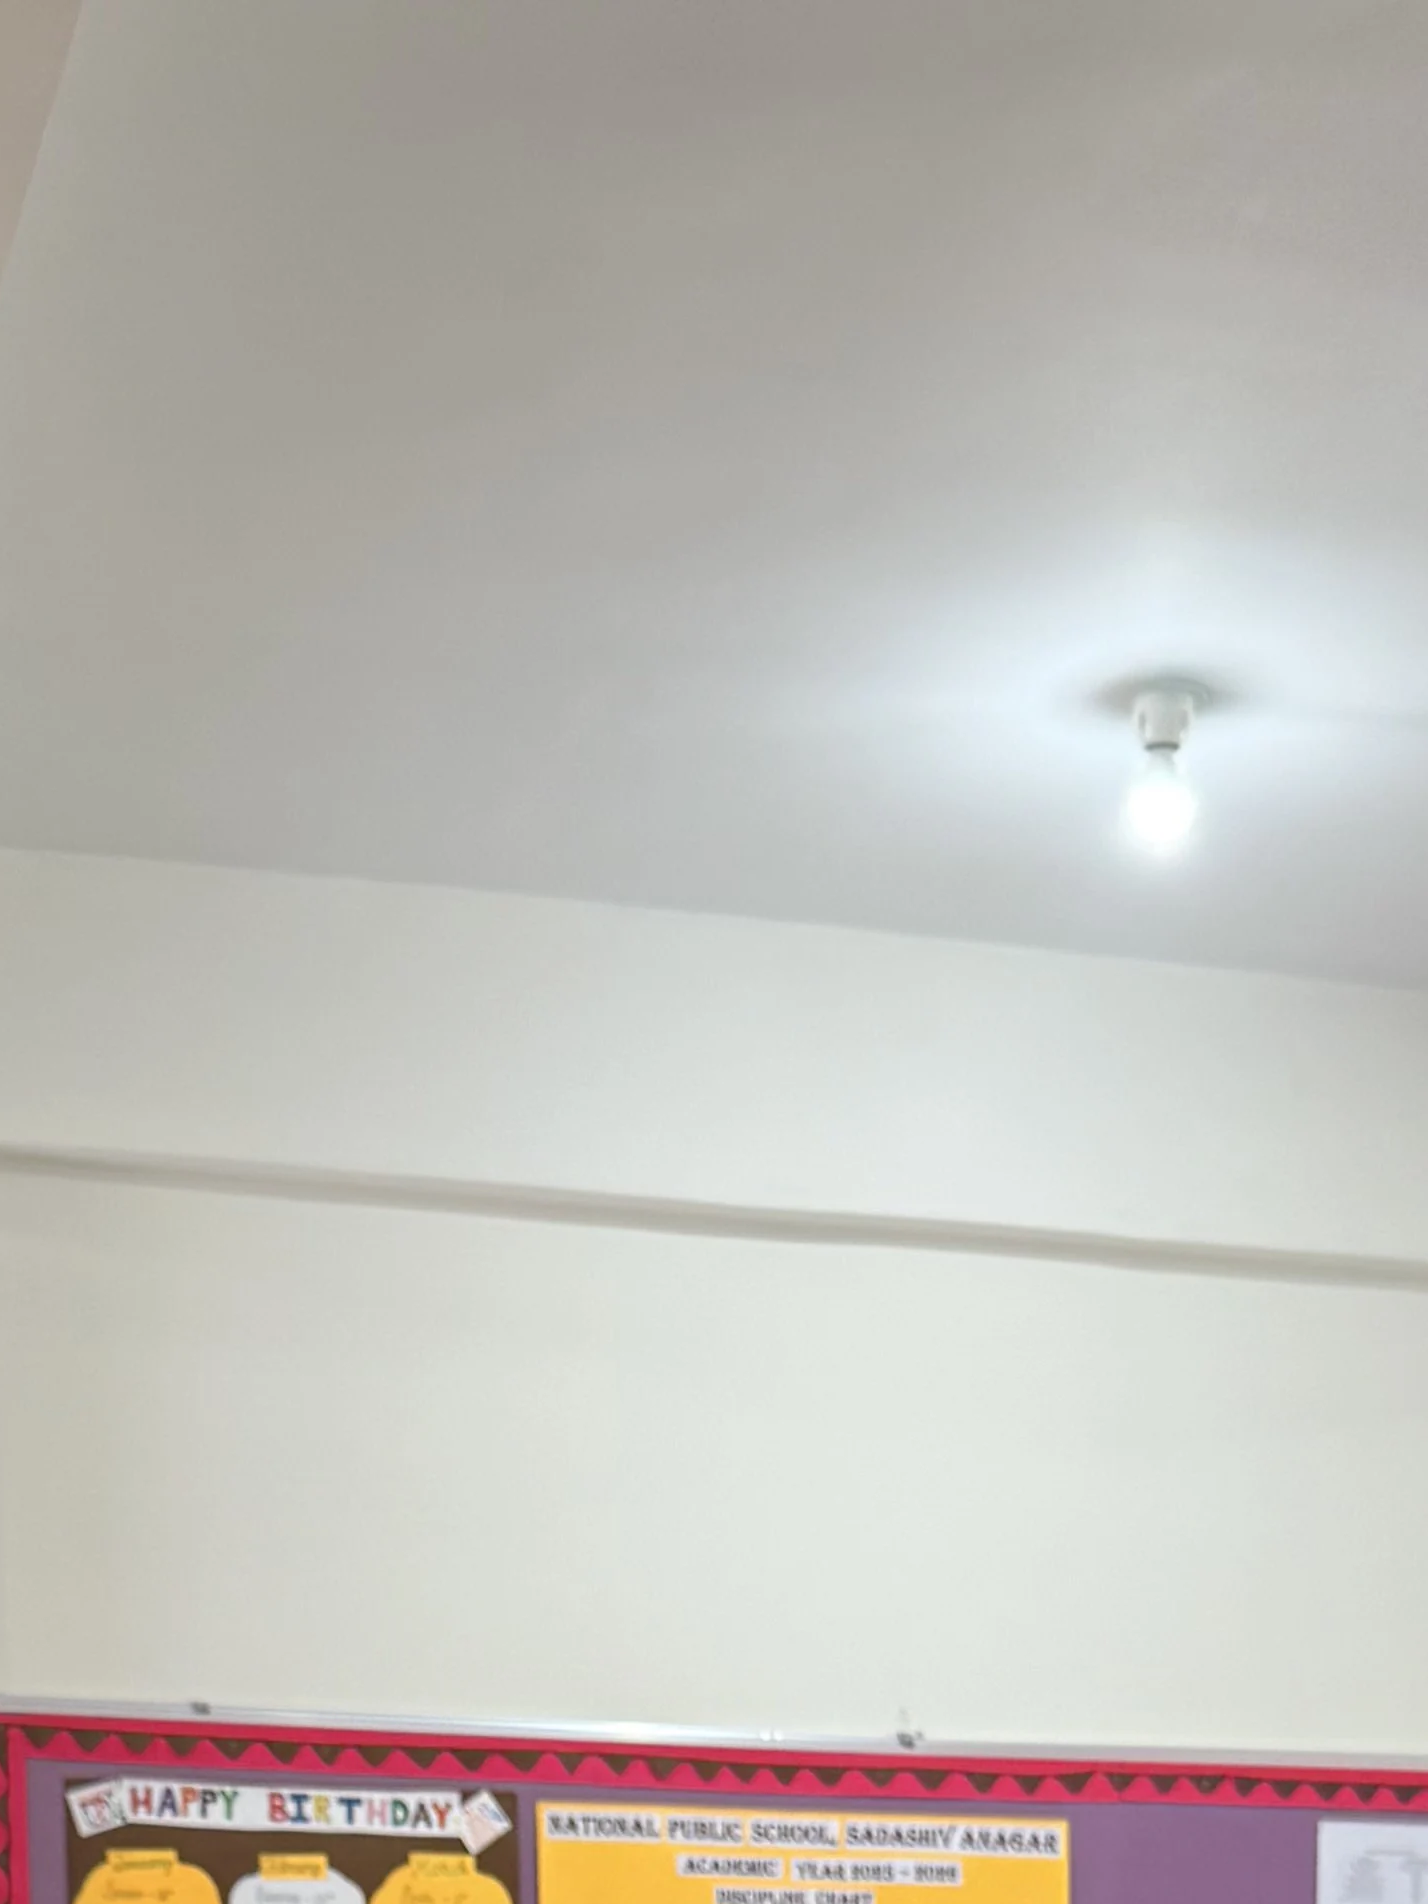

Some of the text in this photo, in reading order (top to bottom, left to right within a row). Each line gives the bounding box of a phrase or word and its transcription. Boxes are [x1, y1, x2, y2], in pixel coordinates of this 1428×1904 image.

[129, 1787, 452, 1829] HAPPY BIRTHDAY
[547, 1813, 659, 1838] NATIONAL
[668, 1818, 742, 1841] PUBLIC
[682, 1857, 776, 1876] ACADEMIC
[795, 1863, 846, 1882] YEAR
